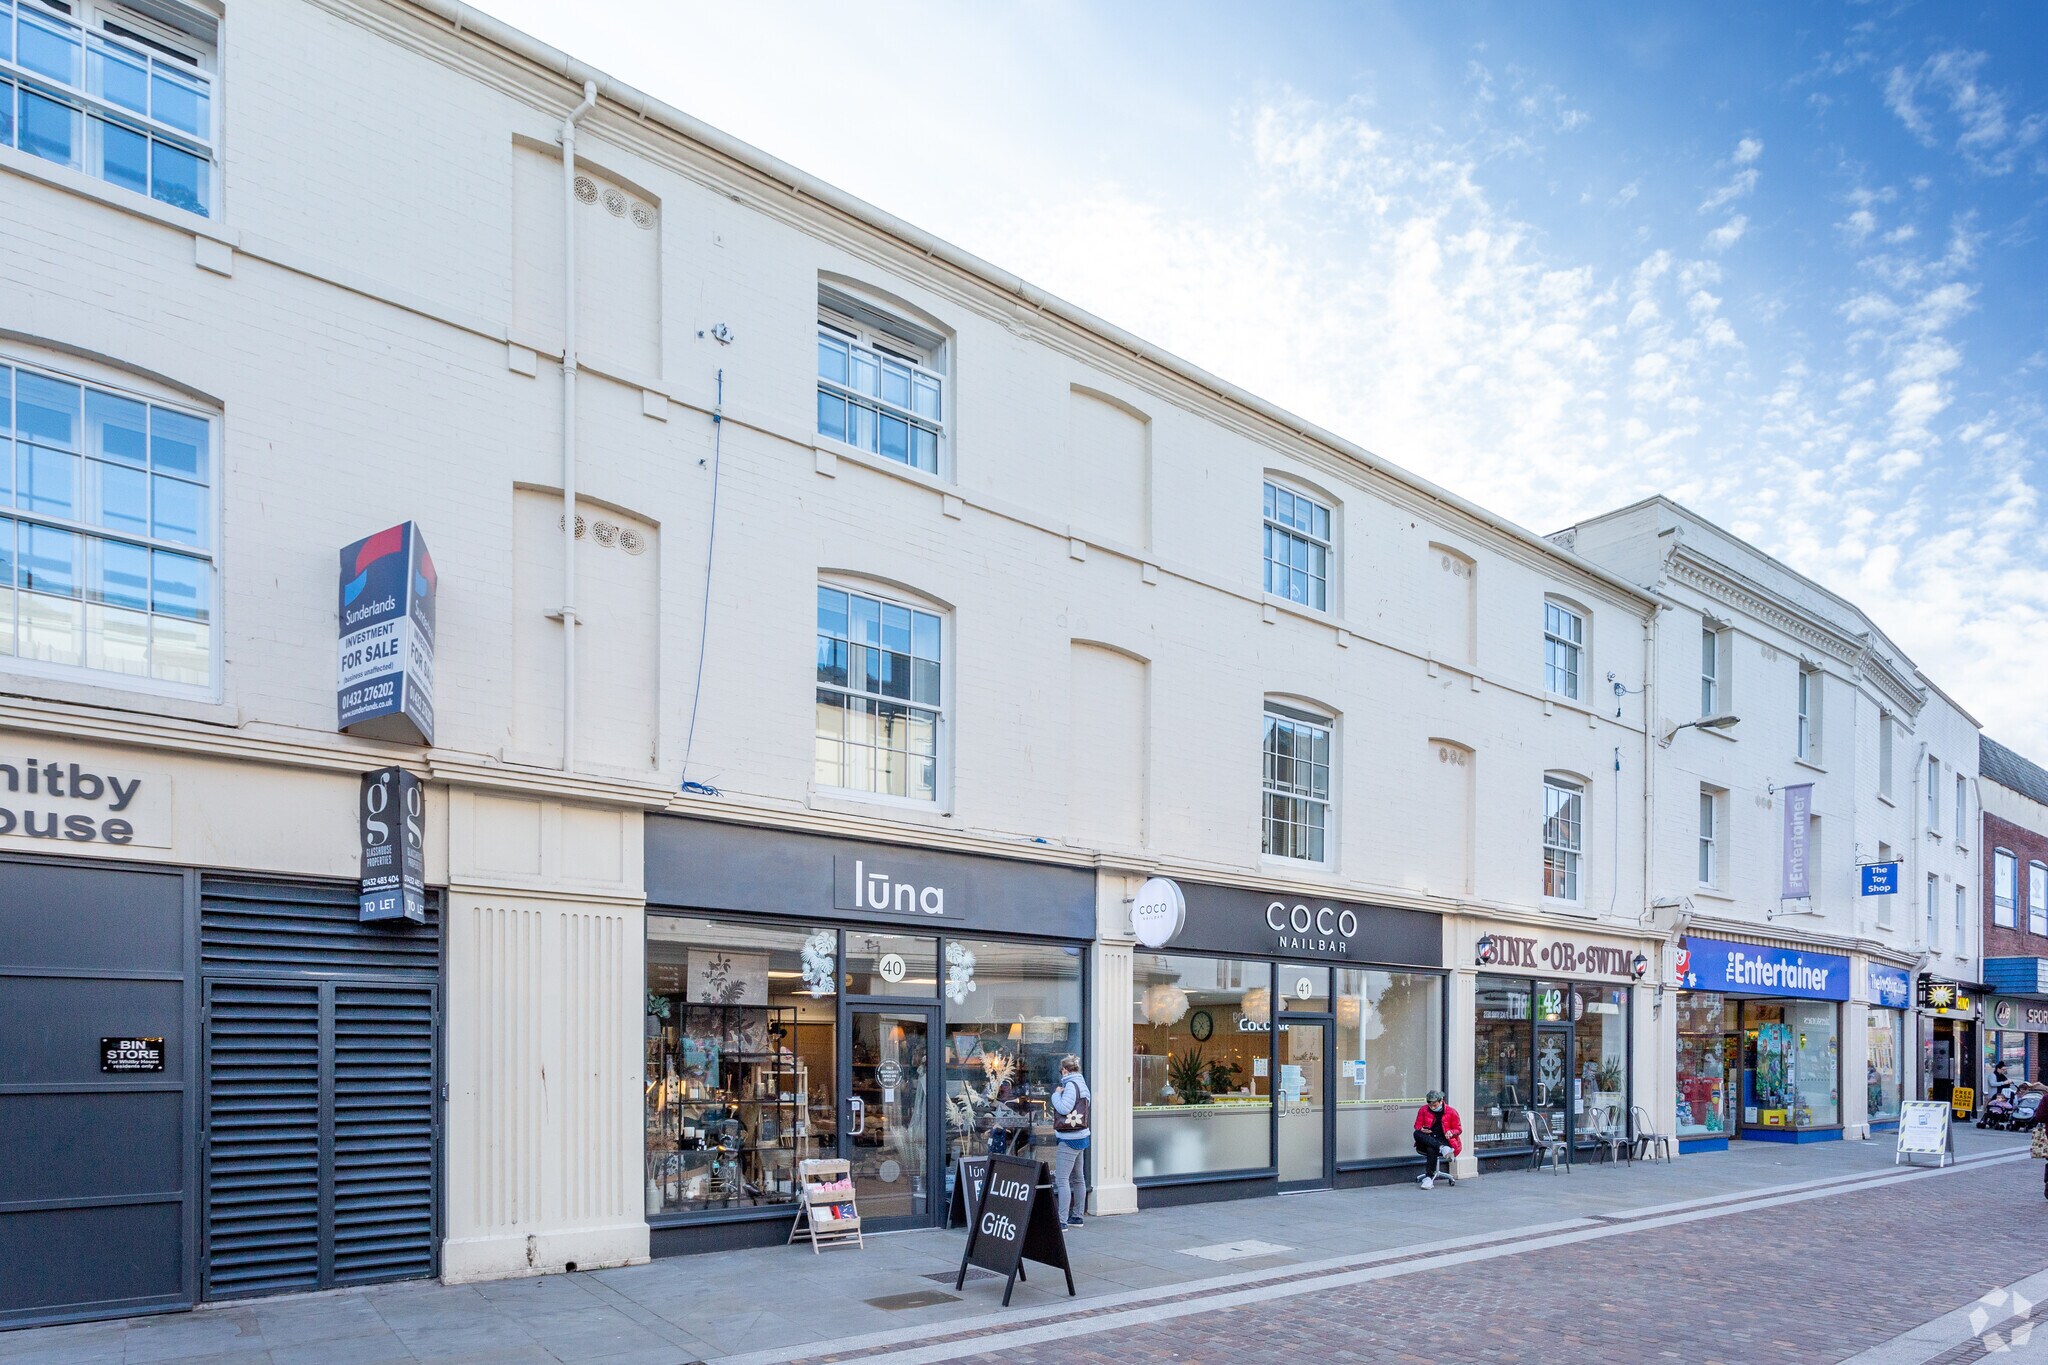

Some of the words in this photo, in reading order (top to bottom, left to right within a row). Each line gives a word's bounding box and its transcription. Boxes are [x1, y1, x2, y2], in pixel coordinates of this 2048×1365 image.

[345, 594, 396, 626] Sunderlands
[345, 622, 395, 649] INVESTMENT
[341, 649, 362, 672] FOR
[365, 638, 399, 663] SALE
[342, 689, 362, 709] 01432
[364, 681, 394, 702] 276202
[0, 758, 142, 812] itby
[0, 806, 134, 845] ouse
[1789, 796, 1805, 881] Entertainer
[366, 844, 392, 857] GLASSHOUSE
[366, 855, 392, 868] PROPERTIES
[1871, 866, 1888, 874] The
[362, 878, 376, 887] 01432
[388, 875, 400, 883] 404
[1871, 876, 1887, 884] Toy
[1868, 885, 1891, 893] Shop
[364, 901, 376, 912] TO
[379, 898, 396, 911] LET
[407, 900, 416, 912] TO
[1139, 902, 1167, 915] COCO
[1265, 901, 1358, 938] COCO
[1278, 935, 1347, 953] NAILBAR
[1486, 934, 1538, 968] SINK
[1550, 941, 1578, 972] OR
[1585, 945, 1633, 977] SWIM
[882, 960, 902, 976] 40
[1726, 951, 1735, 983] The
[1734, 952, 1829, 991] Entertainer
[1298, 983, 1309, 995] 41
[1543, 989, 1562, 1014] 42
[2028, 1008, 2048, 1024] SPOR
[120, 1040, 147, 1050] BIN
[107, 1050, 160, 1059] STORE
[1192, 1110, 1213, 1118] COCO
[1290, 1107, 1310, 1115] COCO
[968, 1164, 986, 1178] lūn
[989, 1172, 1031, 1202] Luna
[981, 1212, 1017, 1241] Gifts
